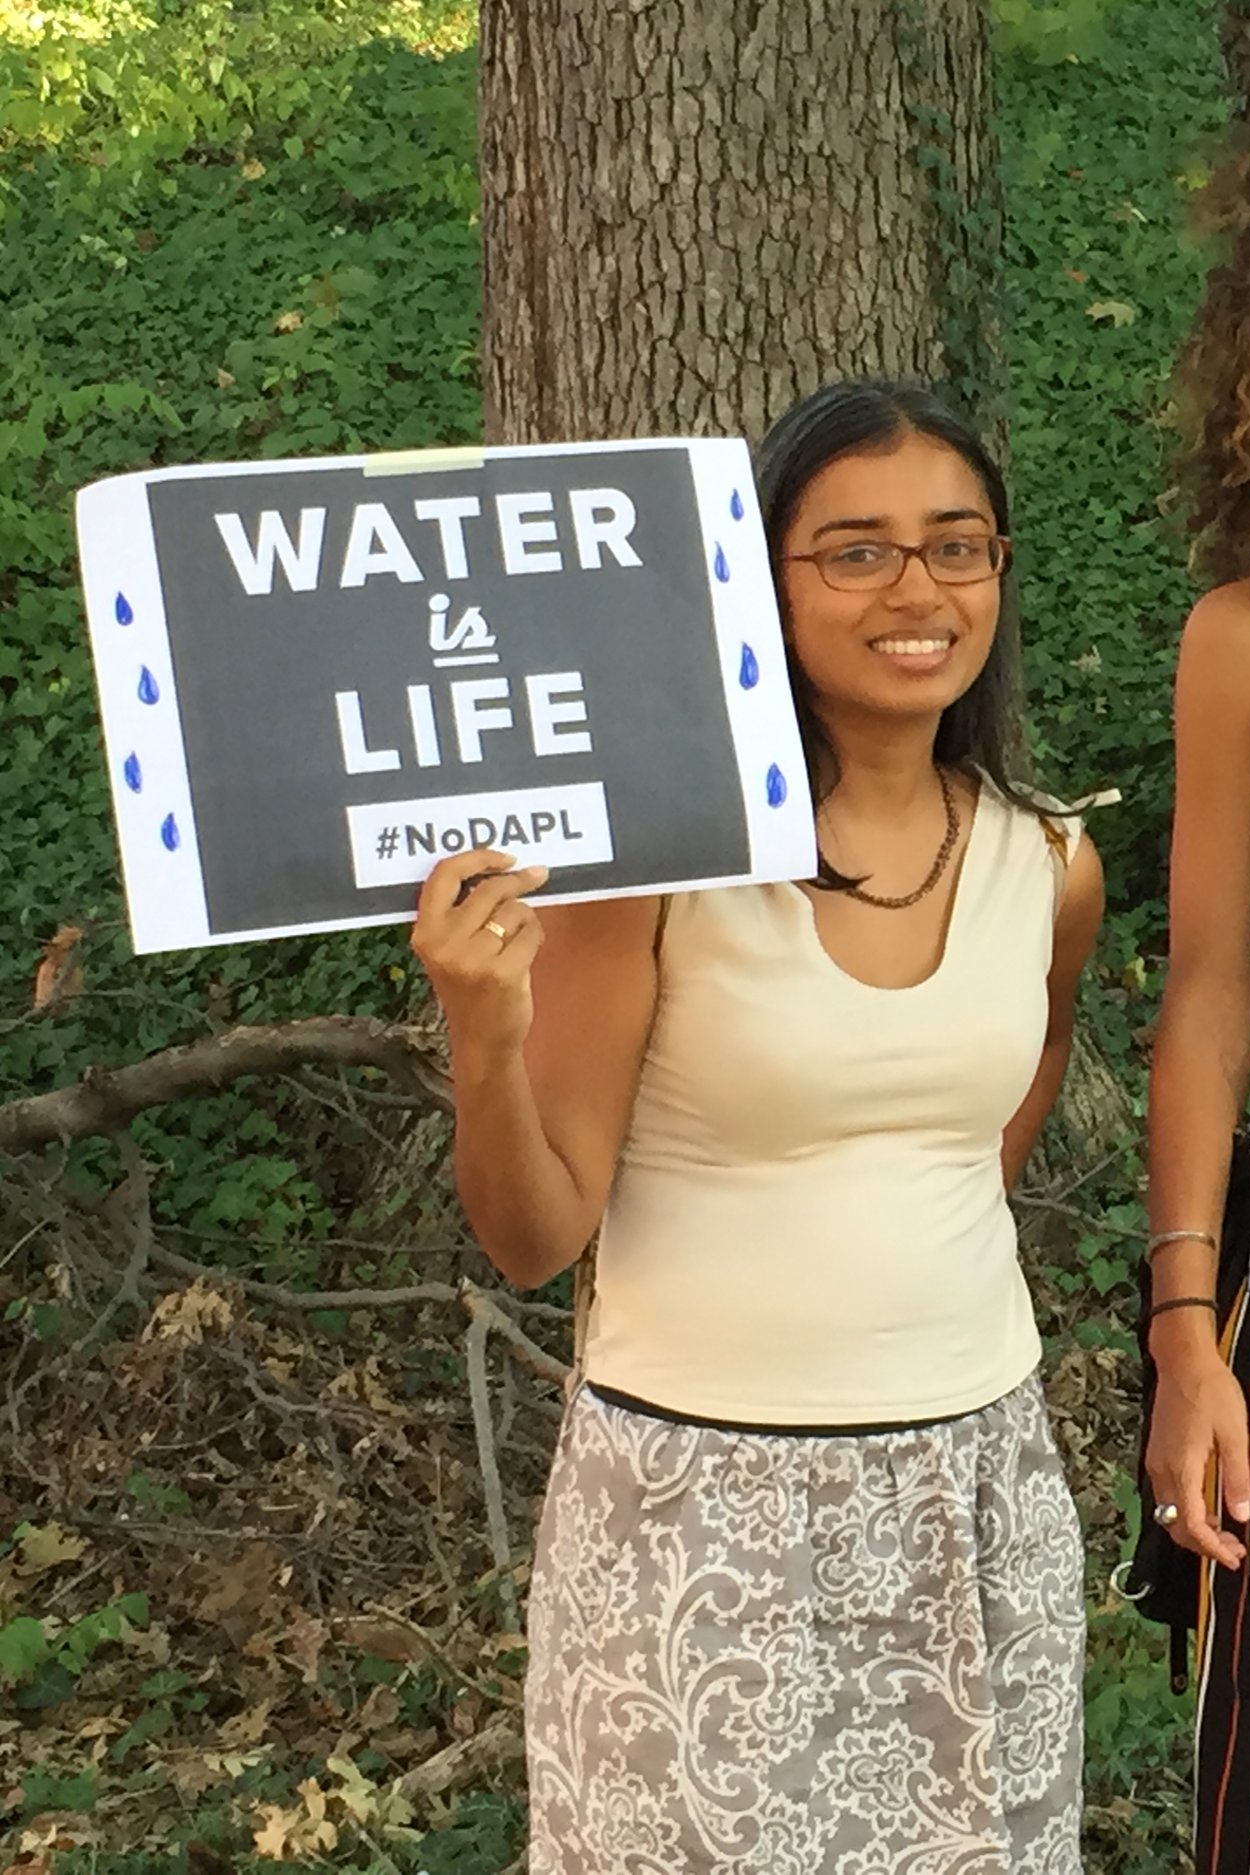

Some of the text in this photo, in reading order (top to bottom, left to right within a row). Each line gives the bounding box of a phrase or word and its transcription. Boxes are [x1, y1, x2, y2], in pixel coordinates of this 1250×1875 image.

[213, 487, 644, 597] WATER
[428, 593, 498, 651] is
[334, 671, 594, 776] LIFE
[374, 809, 584, 860] #NoDAPL
